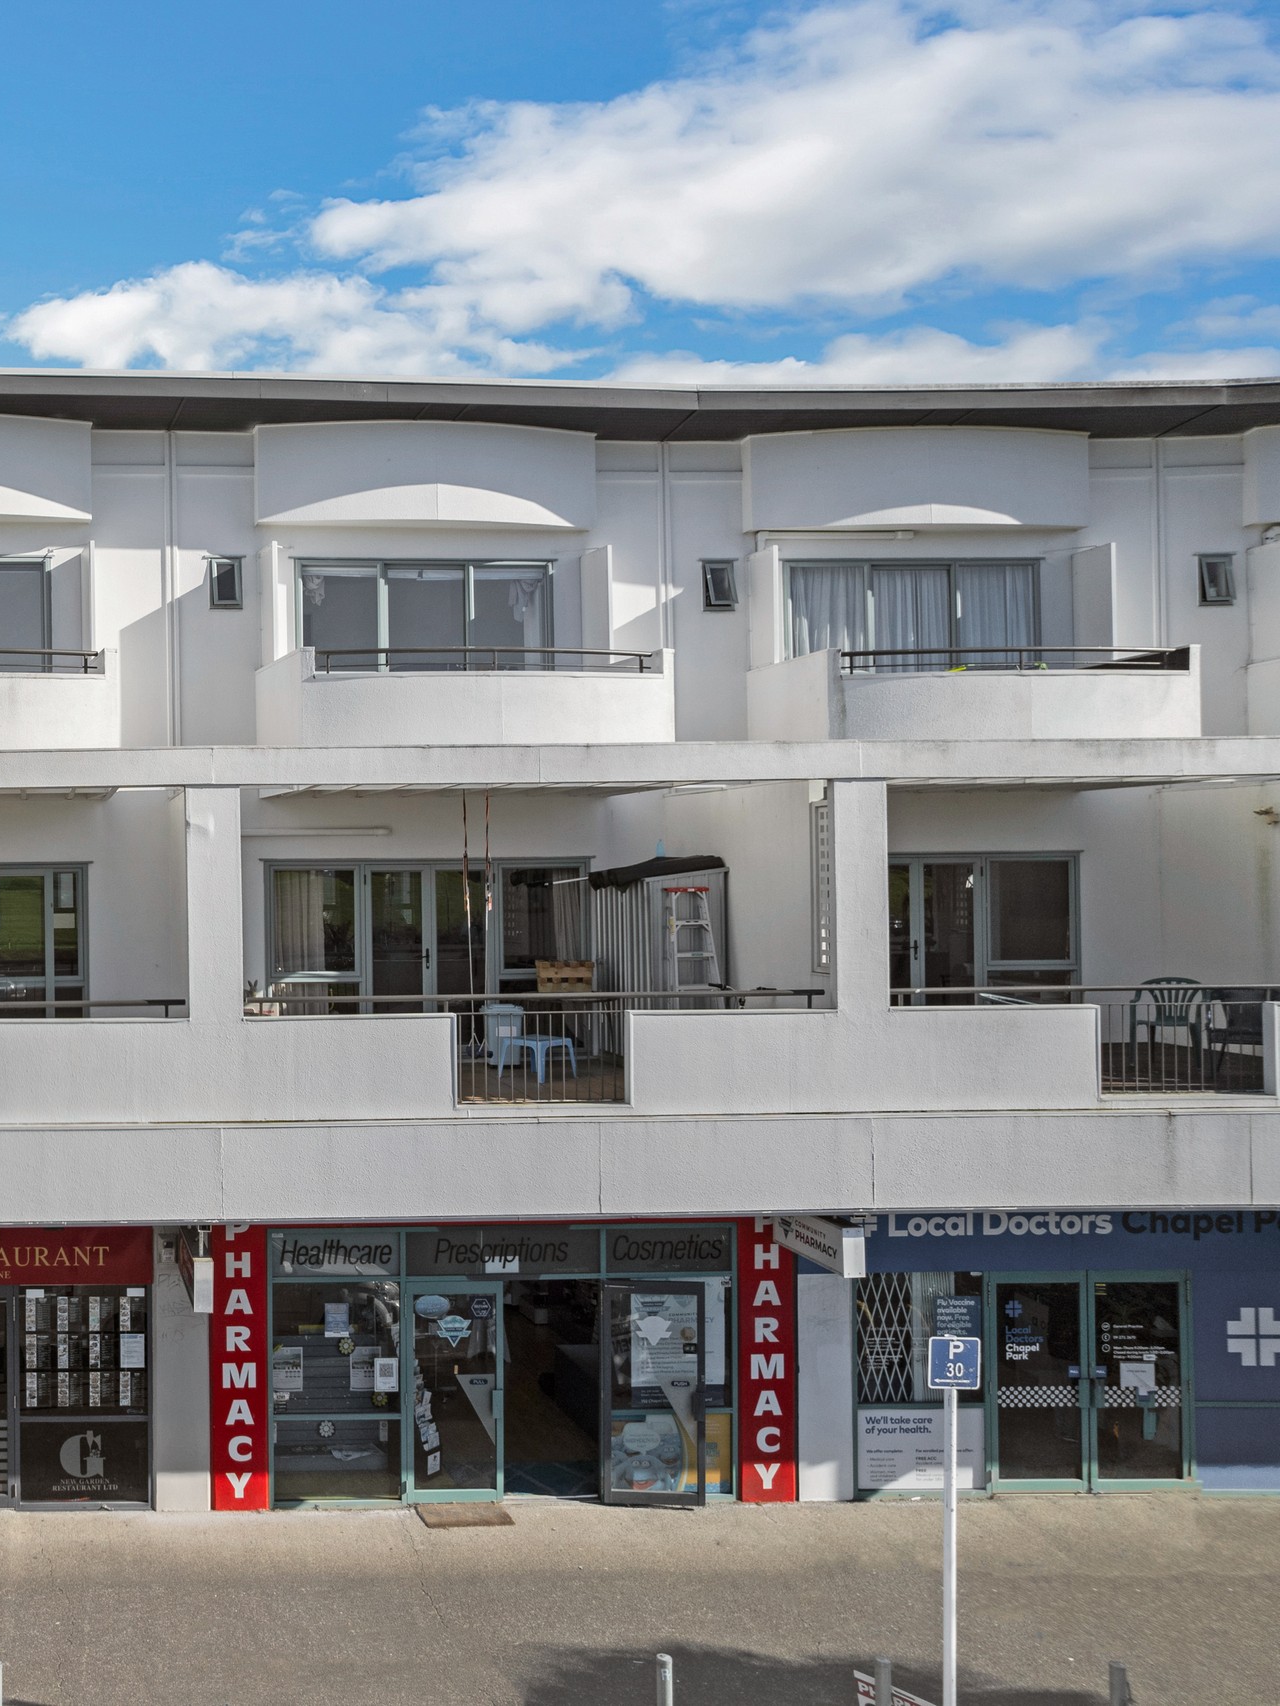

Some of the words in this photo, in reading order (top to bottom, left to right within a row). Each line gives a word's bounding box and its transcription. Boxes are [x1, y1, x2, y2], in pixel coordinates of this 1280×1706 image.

[795, 1219, 827, 1239] COMMUNITY
[888, 1213, 973, 1237] Local
[983, 1212, 1113, 1236] Doctors
[1122, 1211, 1244, 1241] Chapel
[1254, 1211, 1280, 1233] P
[281, 1240, 392, 1265] Healthcare
[434, 1237, 569, 1269] Prescriptions
[613, 1234, 723, 1260] Cosmetics
[795, 1230, 838, 1259] PHARMACY
[1005, 1325, 1031, 1334] Local
[949, 1341, 964, 1360] P
[1006, 1343, 1040, 1353] Chapel
[1006, 1352, 1029, 1360] Park
[946, 1363, 964, 1377] 30
[890, 1416, 911, 1424] take
[865, 1426, 875, 1434] of
[877, 1427, 897, 1435] your
[899, 1425, 932, 1434] health.
